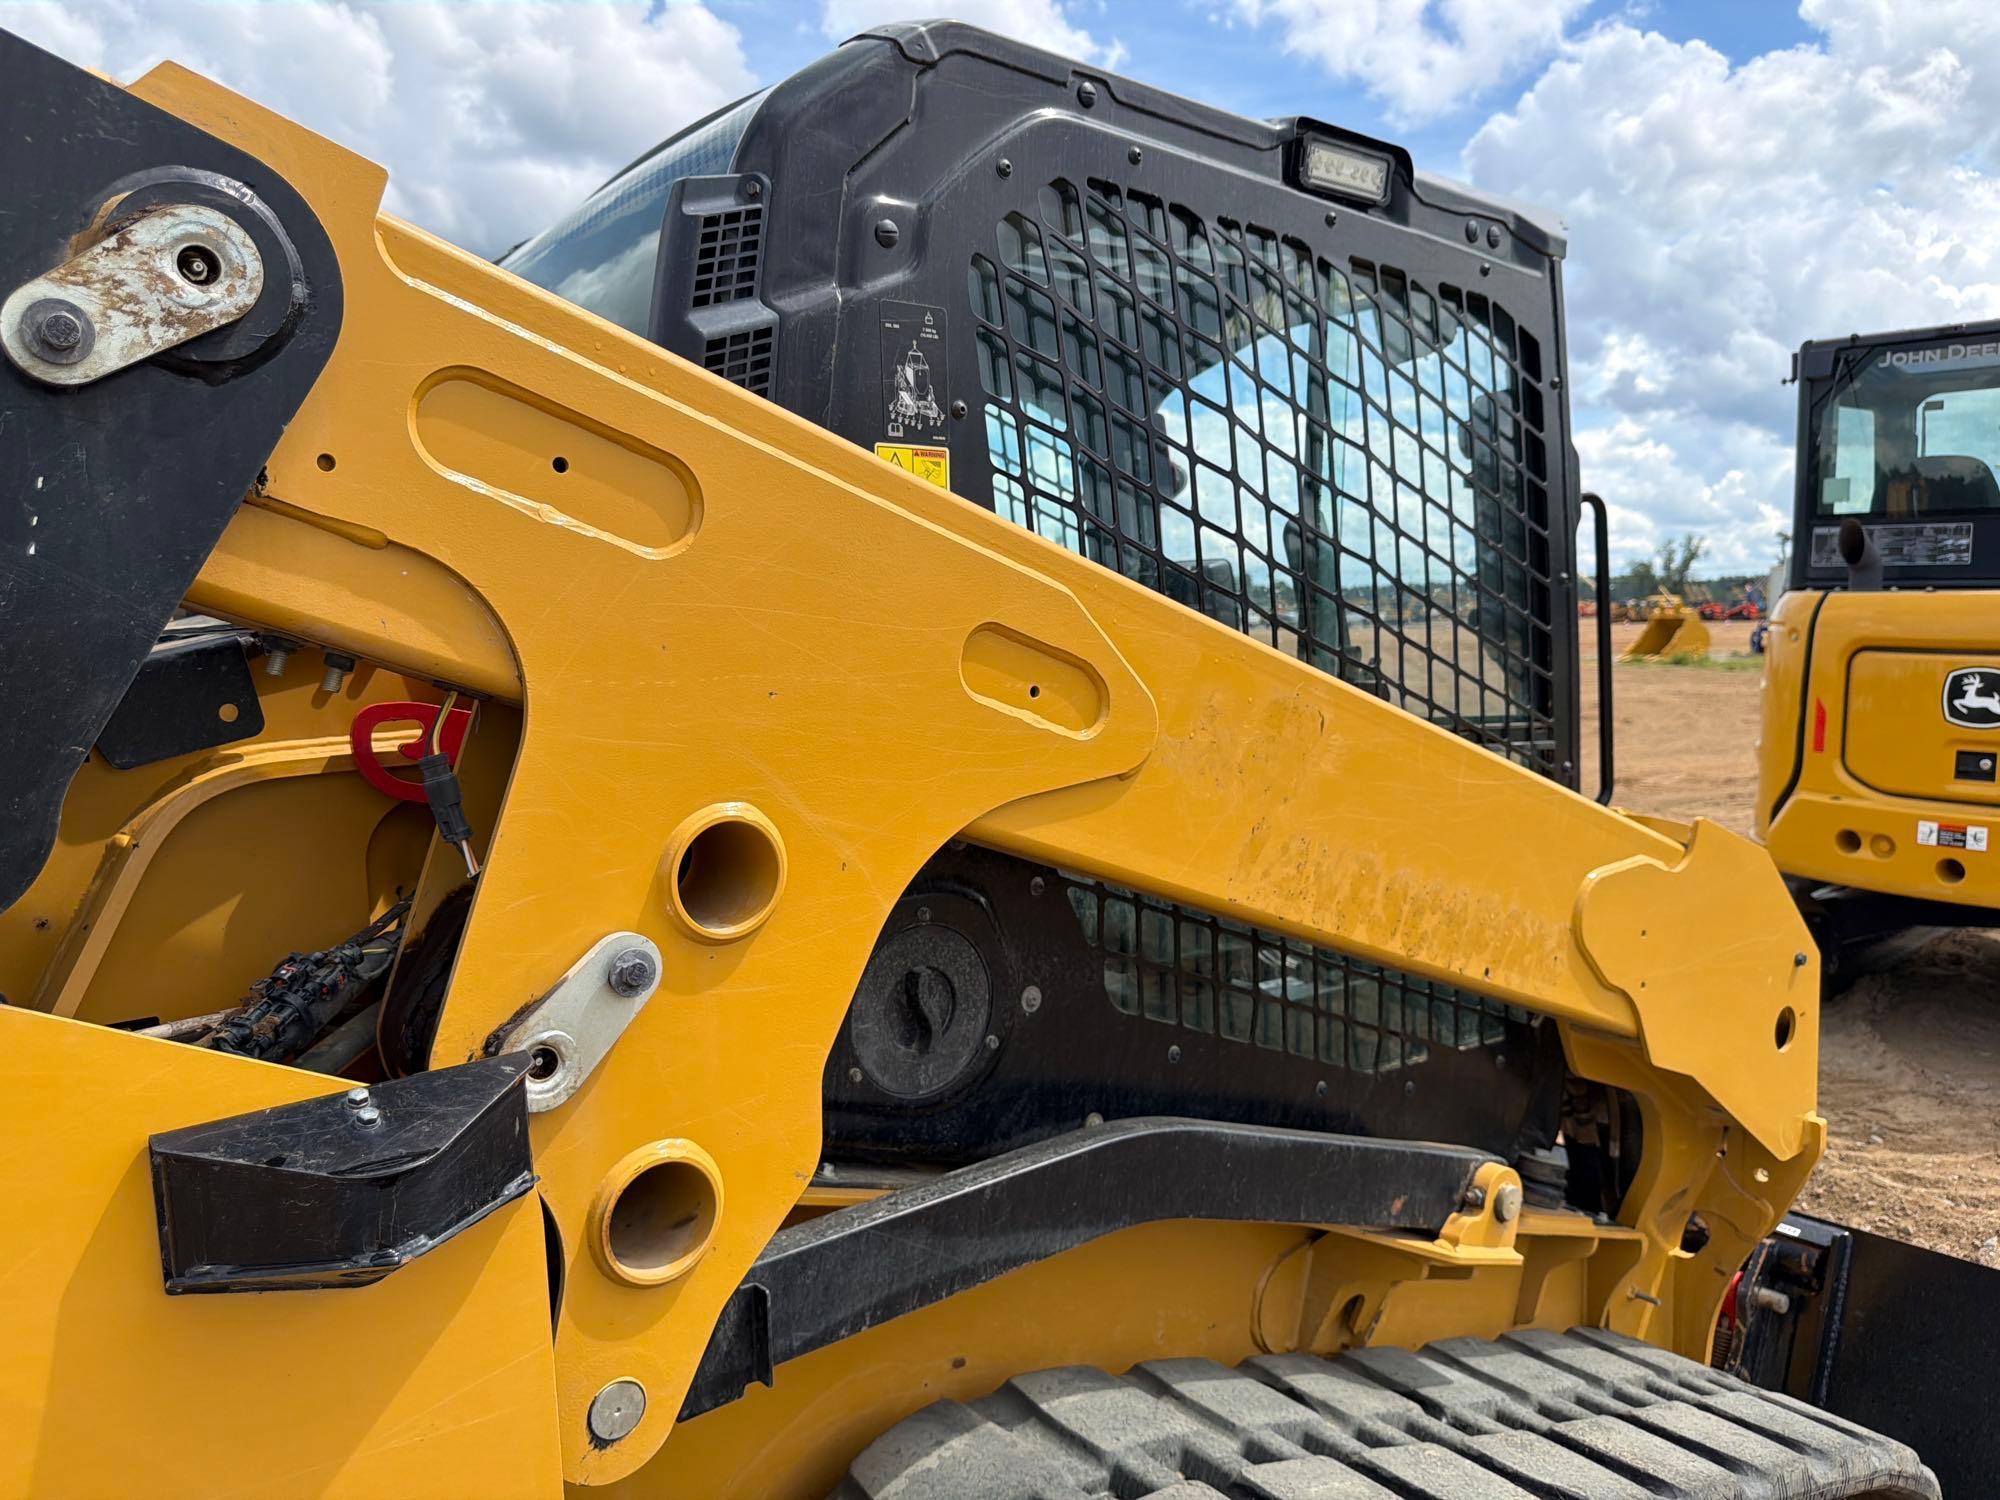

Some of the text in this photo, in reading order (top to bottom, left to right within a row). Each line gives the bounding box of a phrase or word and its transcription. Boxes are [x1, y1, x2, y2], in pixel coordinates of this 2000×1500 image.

[1878, 342, 2000, 368] JOHN DEE
[920, 451, 944, 459] WARNING
